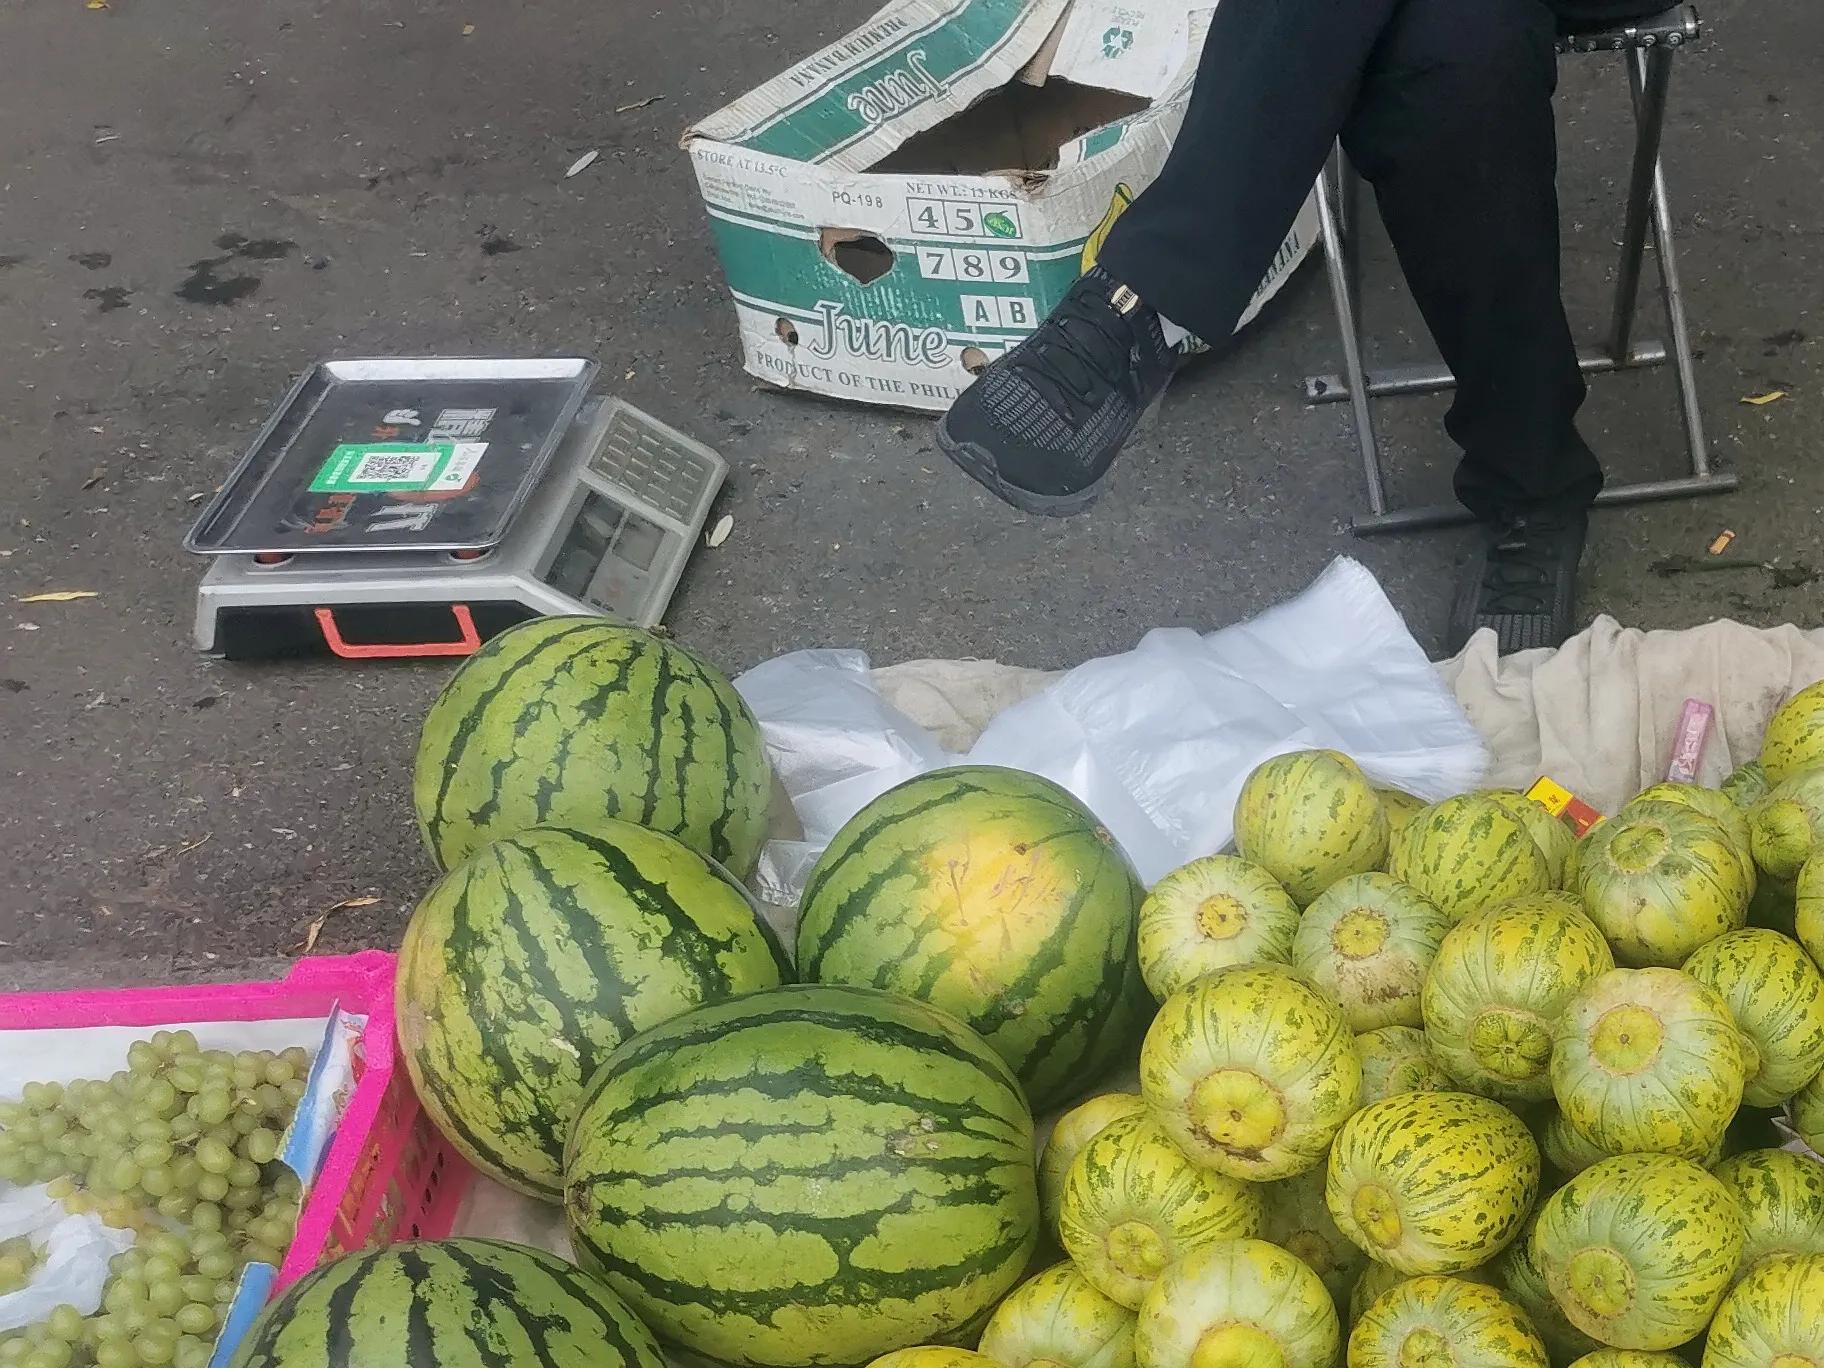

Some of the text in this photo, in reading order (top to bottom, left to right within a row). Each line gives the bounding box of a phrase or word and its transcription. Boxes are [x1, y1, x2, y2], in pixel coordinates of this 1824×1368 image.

[788, 15, 908, 90] PREMIUM BANANA
[847, 49, 953, 127] June
[698, 148, 733, 166] STORE
[737, 158, 750, 170] AT
[831, 191, 884, 209] PQ-198
[906, 181, 933, 195] NET
[918, 206, 940, 230] 4
[954, 208, 975, 232] 5
[926, 252, 1022, 280] 7 8 9
[974, 300, 1027, 324] A B
[807, 300, 953, 370] June
[756, 350, 833, 383] PRODUCT
[838, 371, 860, 387] OF
[865, 377, 905, 394] THE
